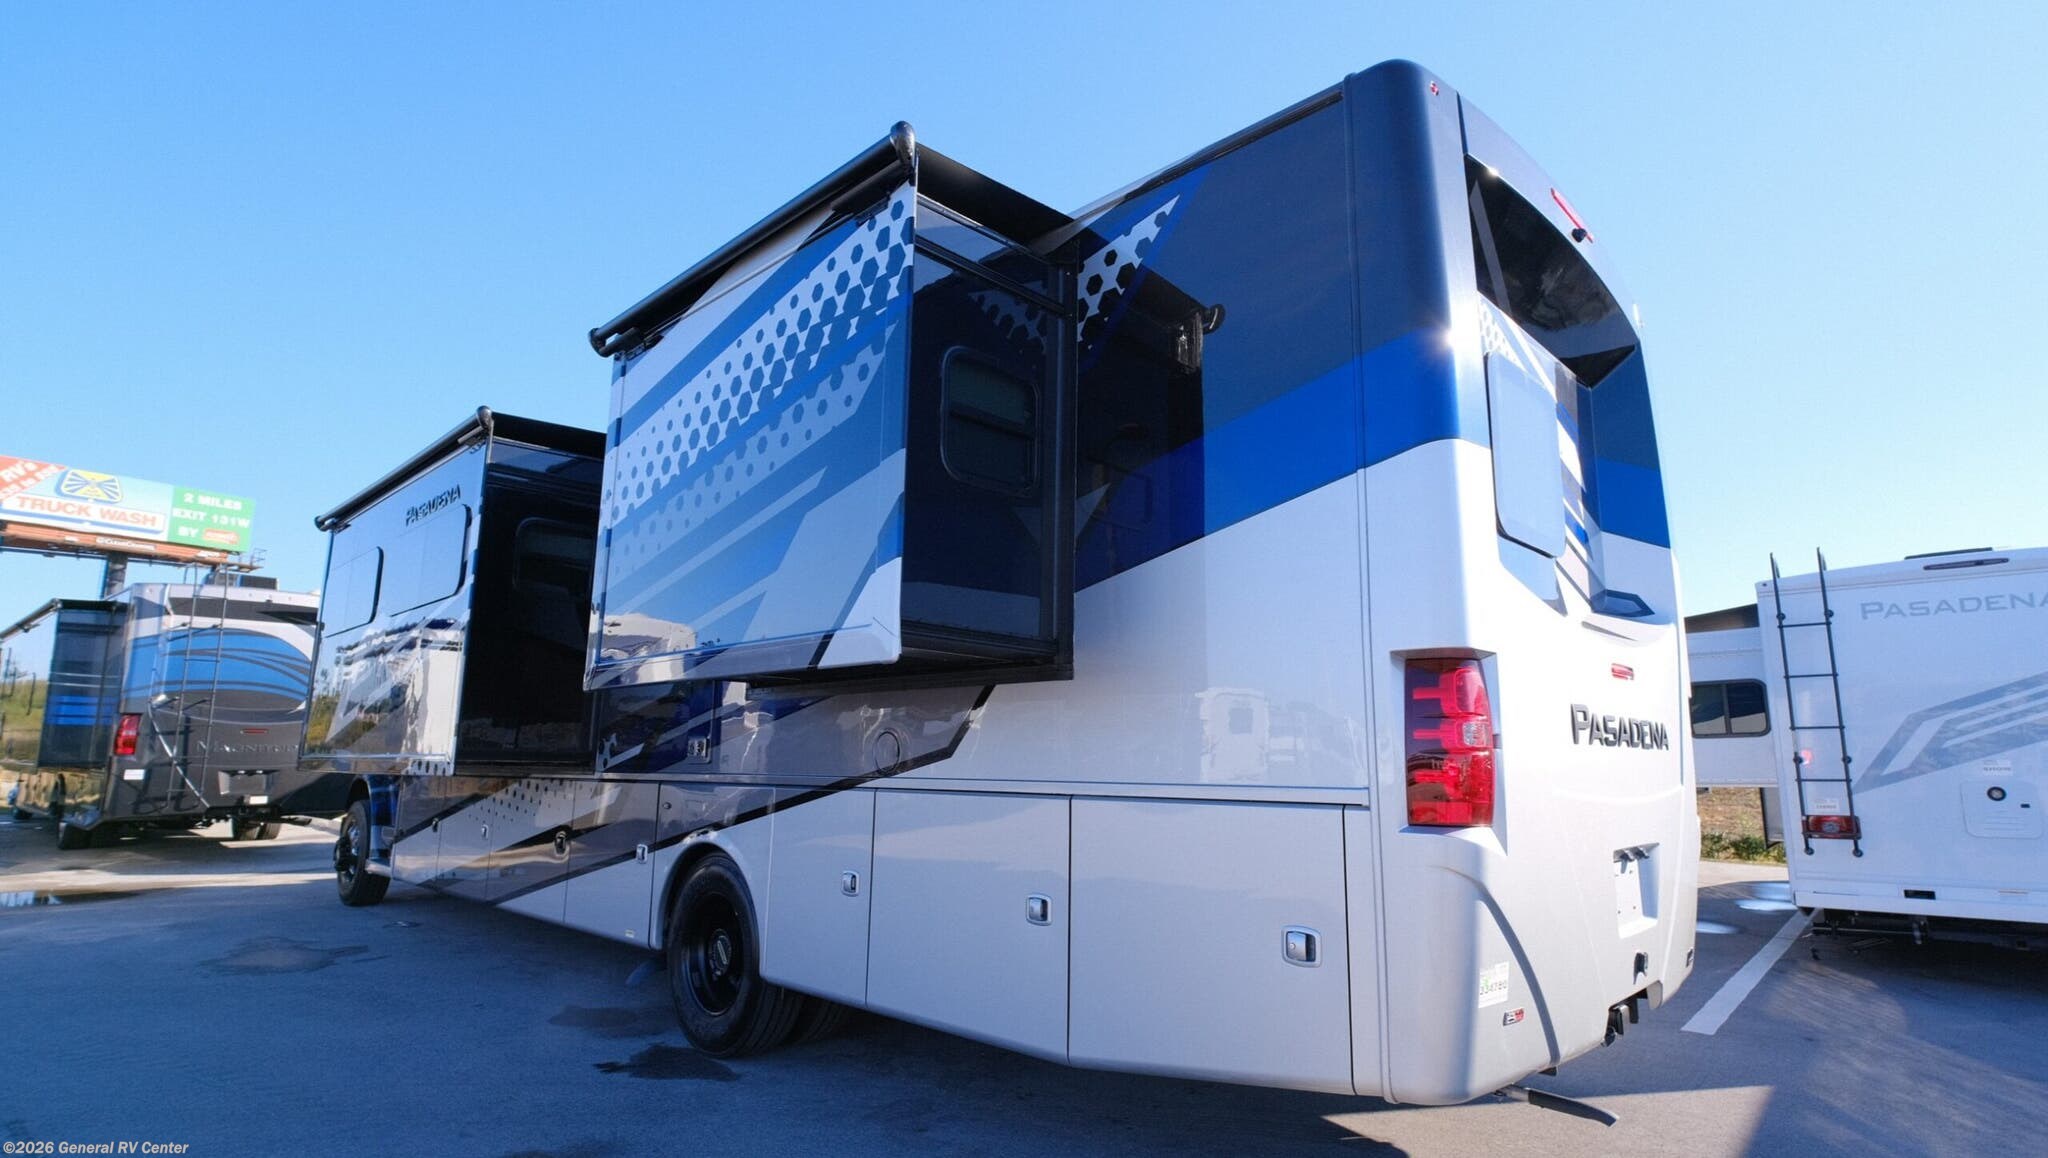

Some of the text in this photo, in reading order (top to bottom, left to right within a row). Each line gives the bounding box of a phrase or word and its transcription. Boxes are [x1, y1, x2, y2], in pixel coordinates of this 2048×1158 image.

[17, 496, 157, 528] TRUCK WASH
[183, 493, 242, 511] 2 MILES
[406, 484, 461, 526] PASADENA
[172, 508, 251, 528] EXIT 131W
[178, 526, 199, 538] BY
[1570, 703, 1669, 751] PASADENA
